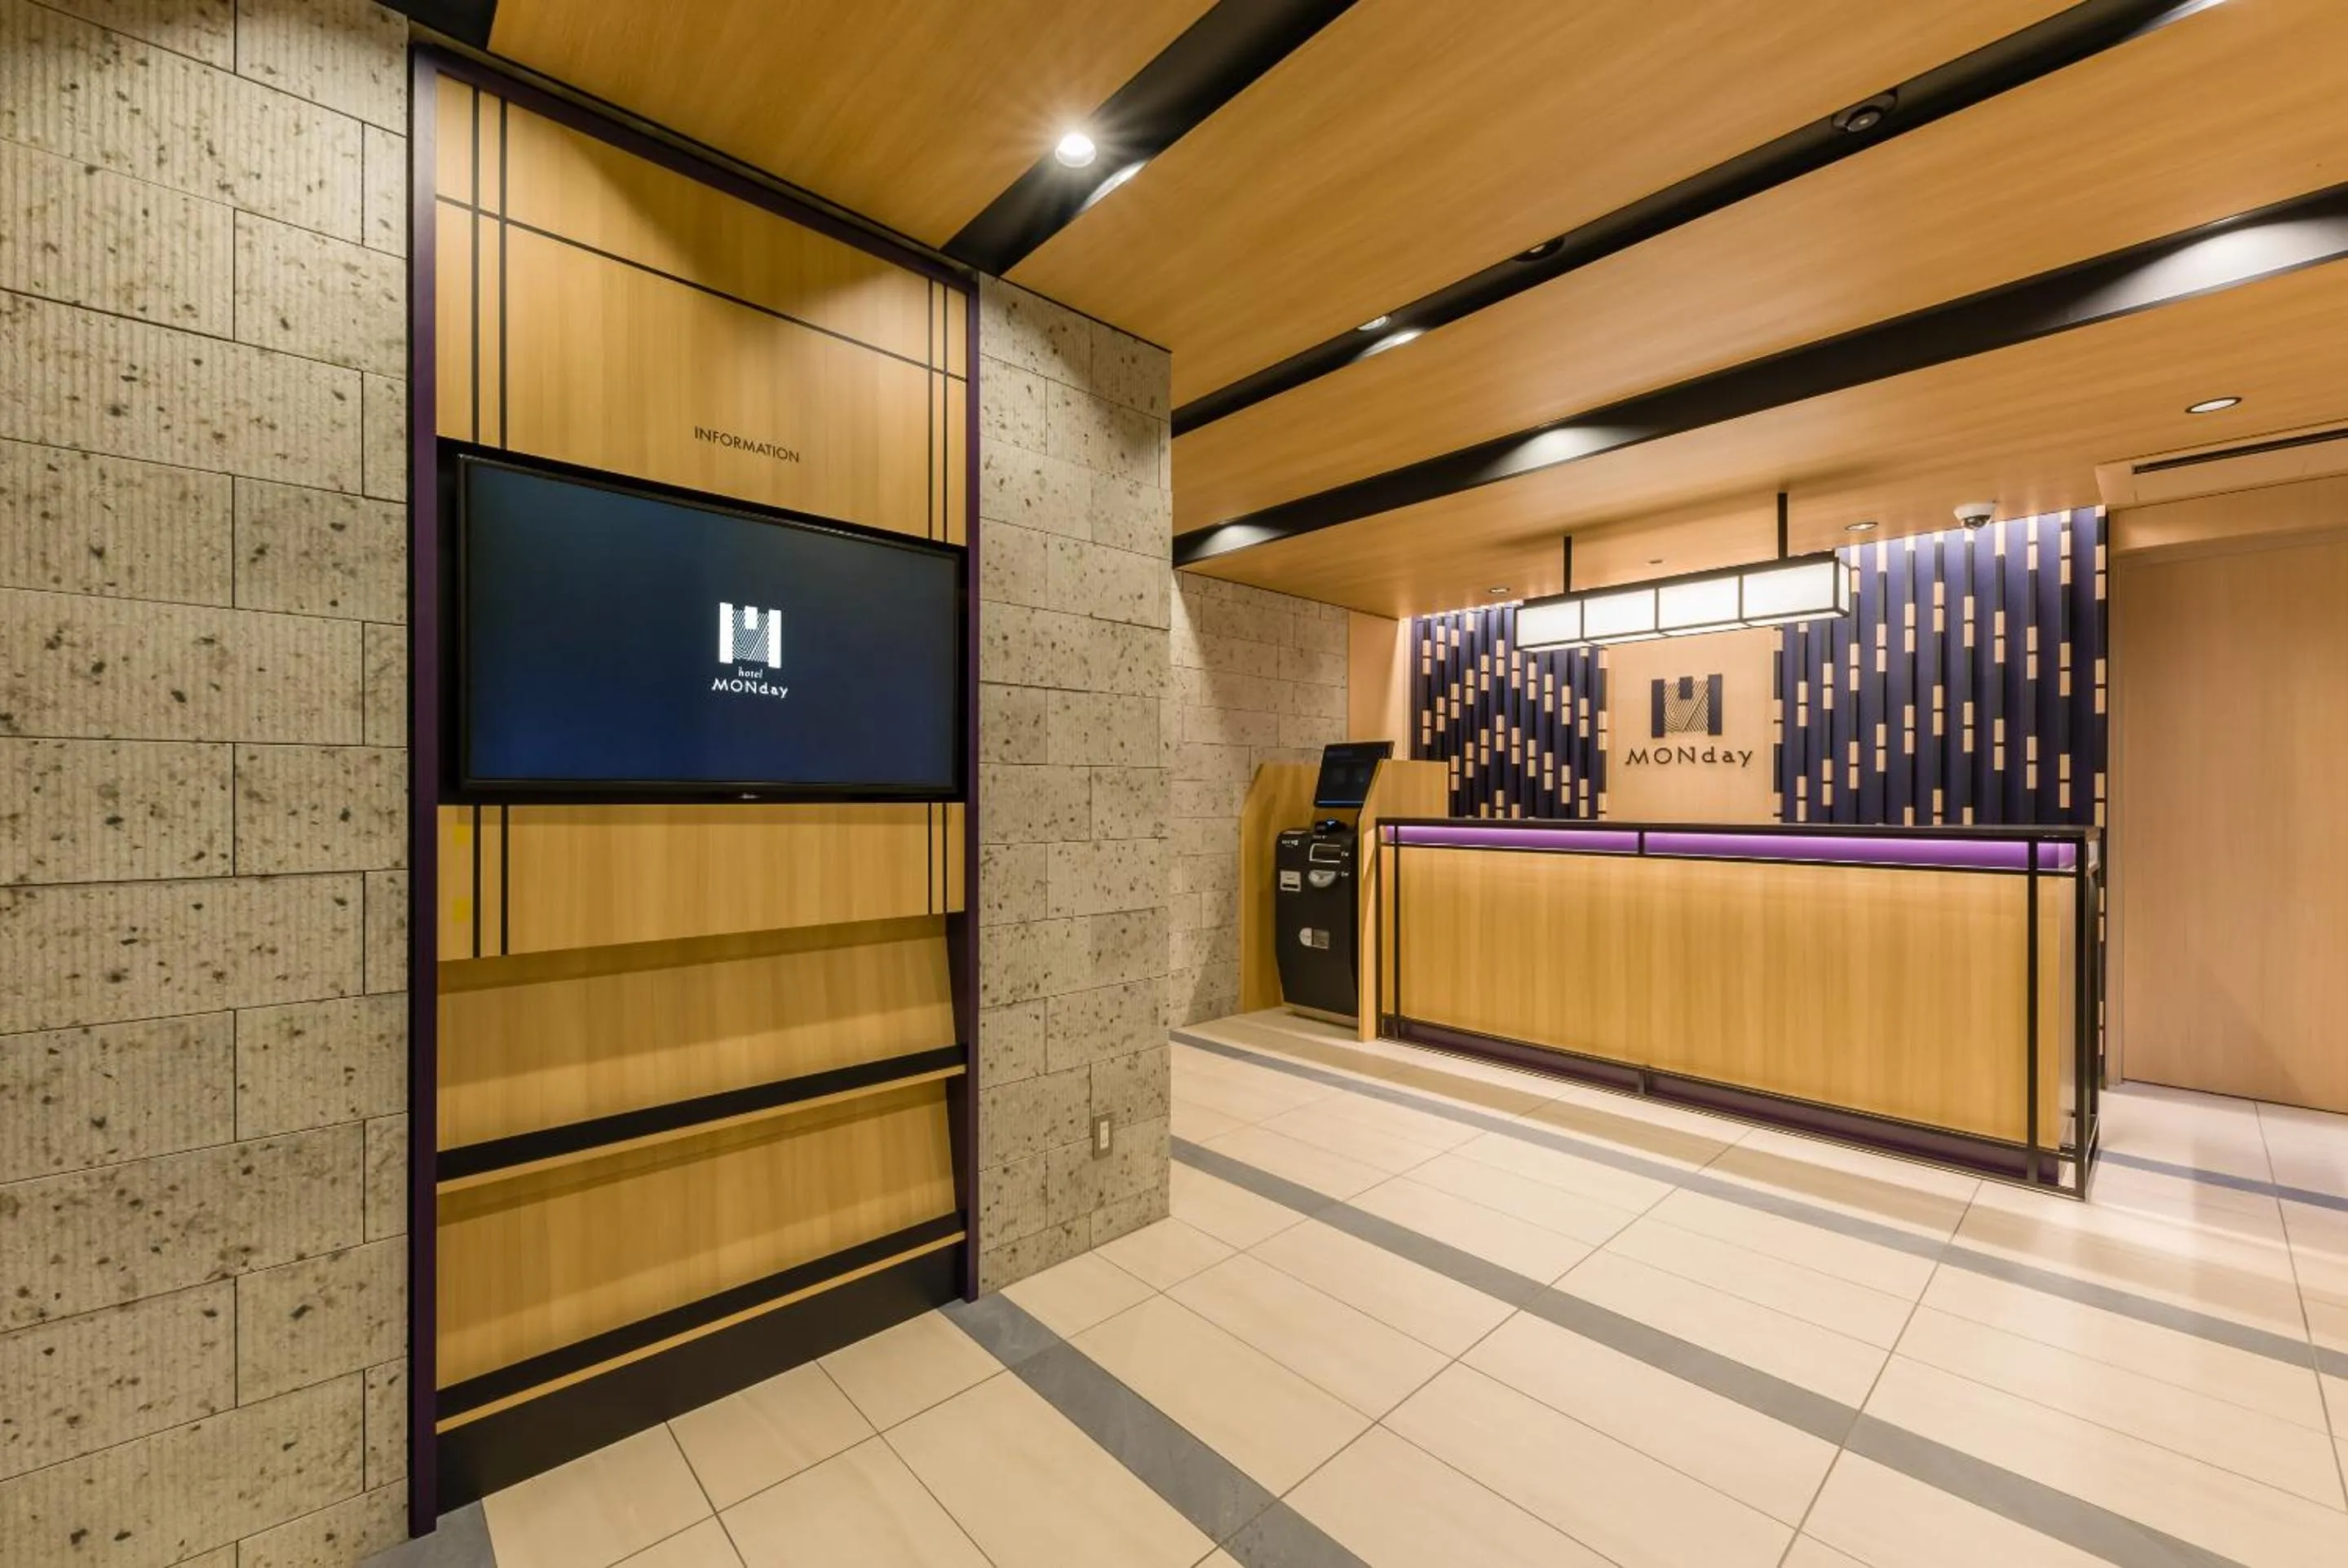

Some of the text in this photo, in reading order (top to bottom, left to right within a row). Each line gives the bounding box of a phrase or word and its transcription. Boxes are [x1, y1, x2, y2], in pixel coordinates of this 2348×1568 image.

[694, 425, 800, 463] INFORMATION
[738, 666, 763, 678] hotel
[711, 678, 789, 699] MONday
[1625, 745, 1753, 768] MONday
